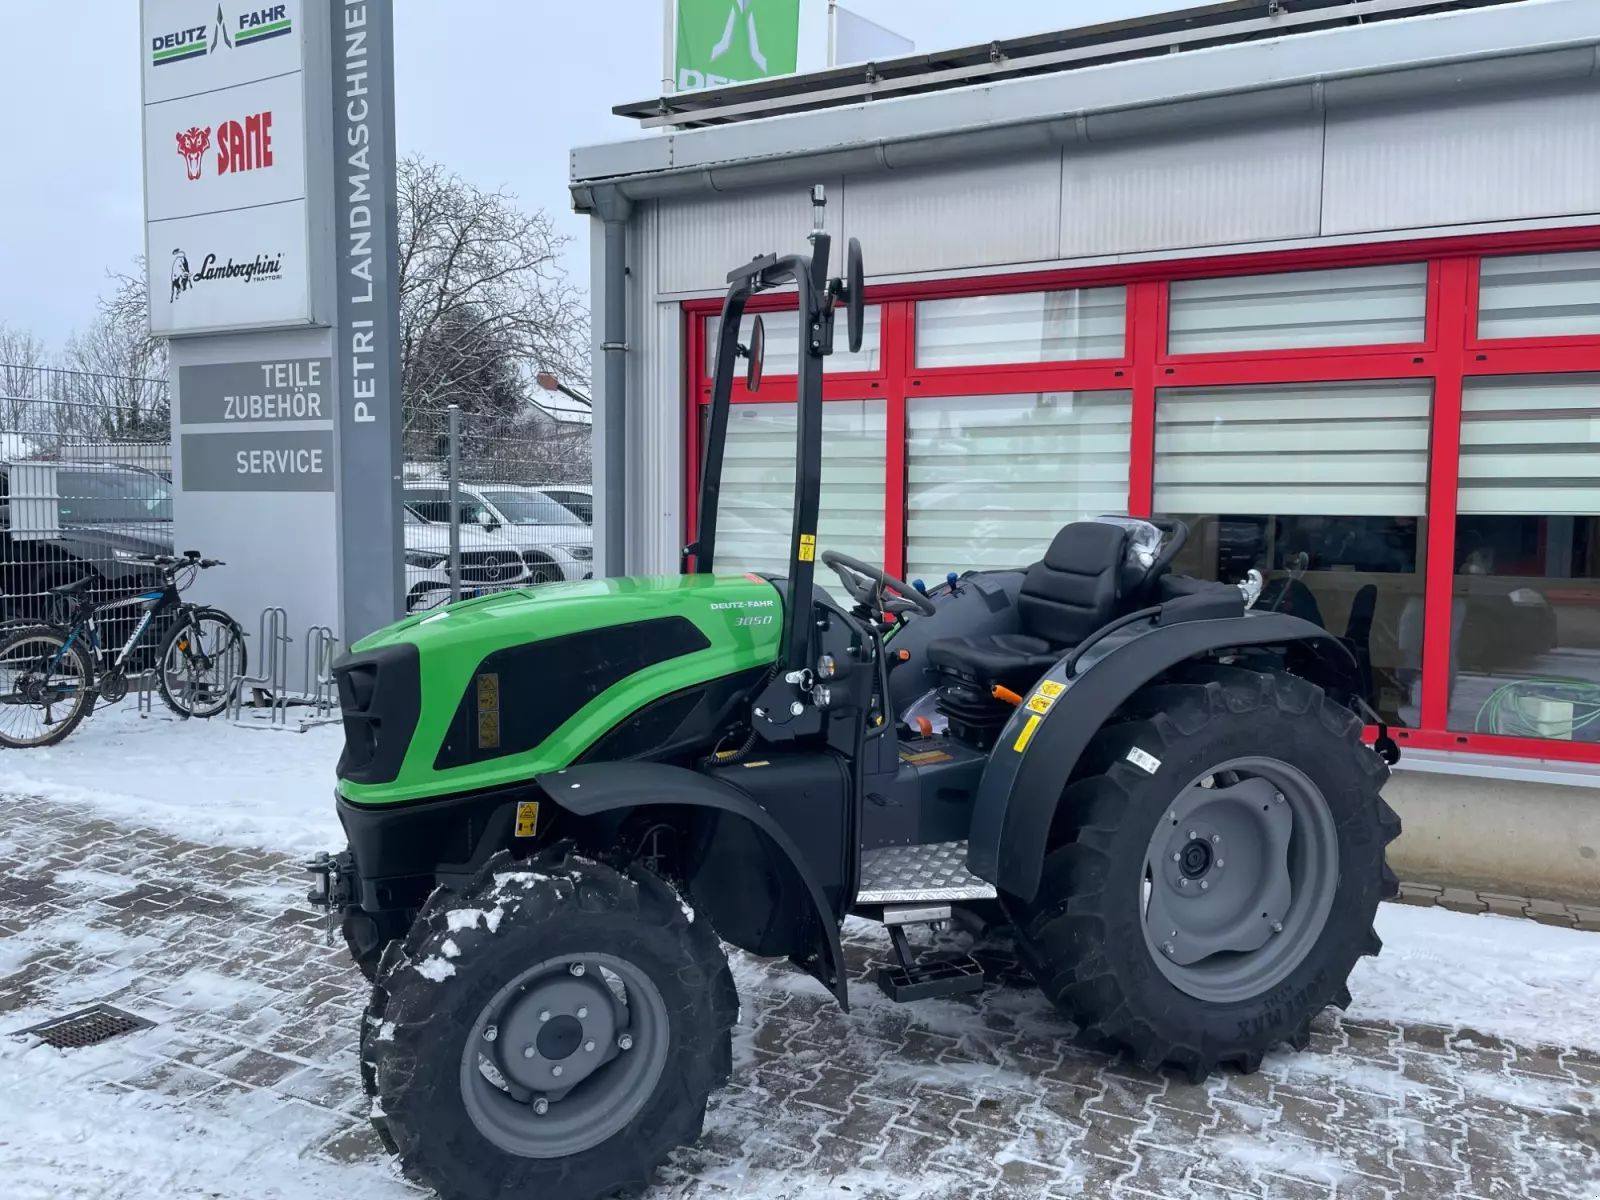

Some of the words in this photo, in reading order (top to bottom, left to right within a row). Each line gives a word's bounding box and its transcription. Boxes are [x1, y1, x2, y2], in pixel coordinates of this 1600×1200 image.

[152, 25, 207, 51] DEUTZ
[239, 4, 286, 30] FAHR
[217, 111, 273, 176] SAME
[345, 0, 373, 303] LANDMASCHINE
[193, 252, 281, 283] Lamborghini
[261, 361, 321, 388] TEILE
[352, 320, 375, 422] PETRI
[224, 387, 321, 419] ZUBEHÖR
[236, 449, 323, 474] SERVICE
[710, 600, 774, 609] DEUTZ-FAHR
